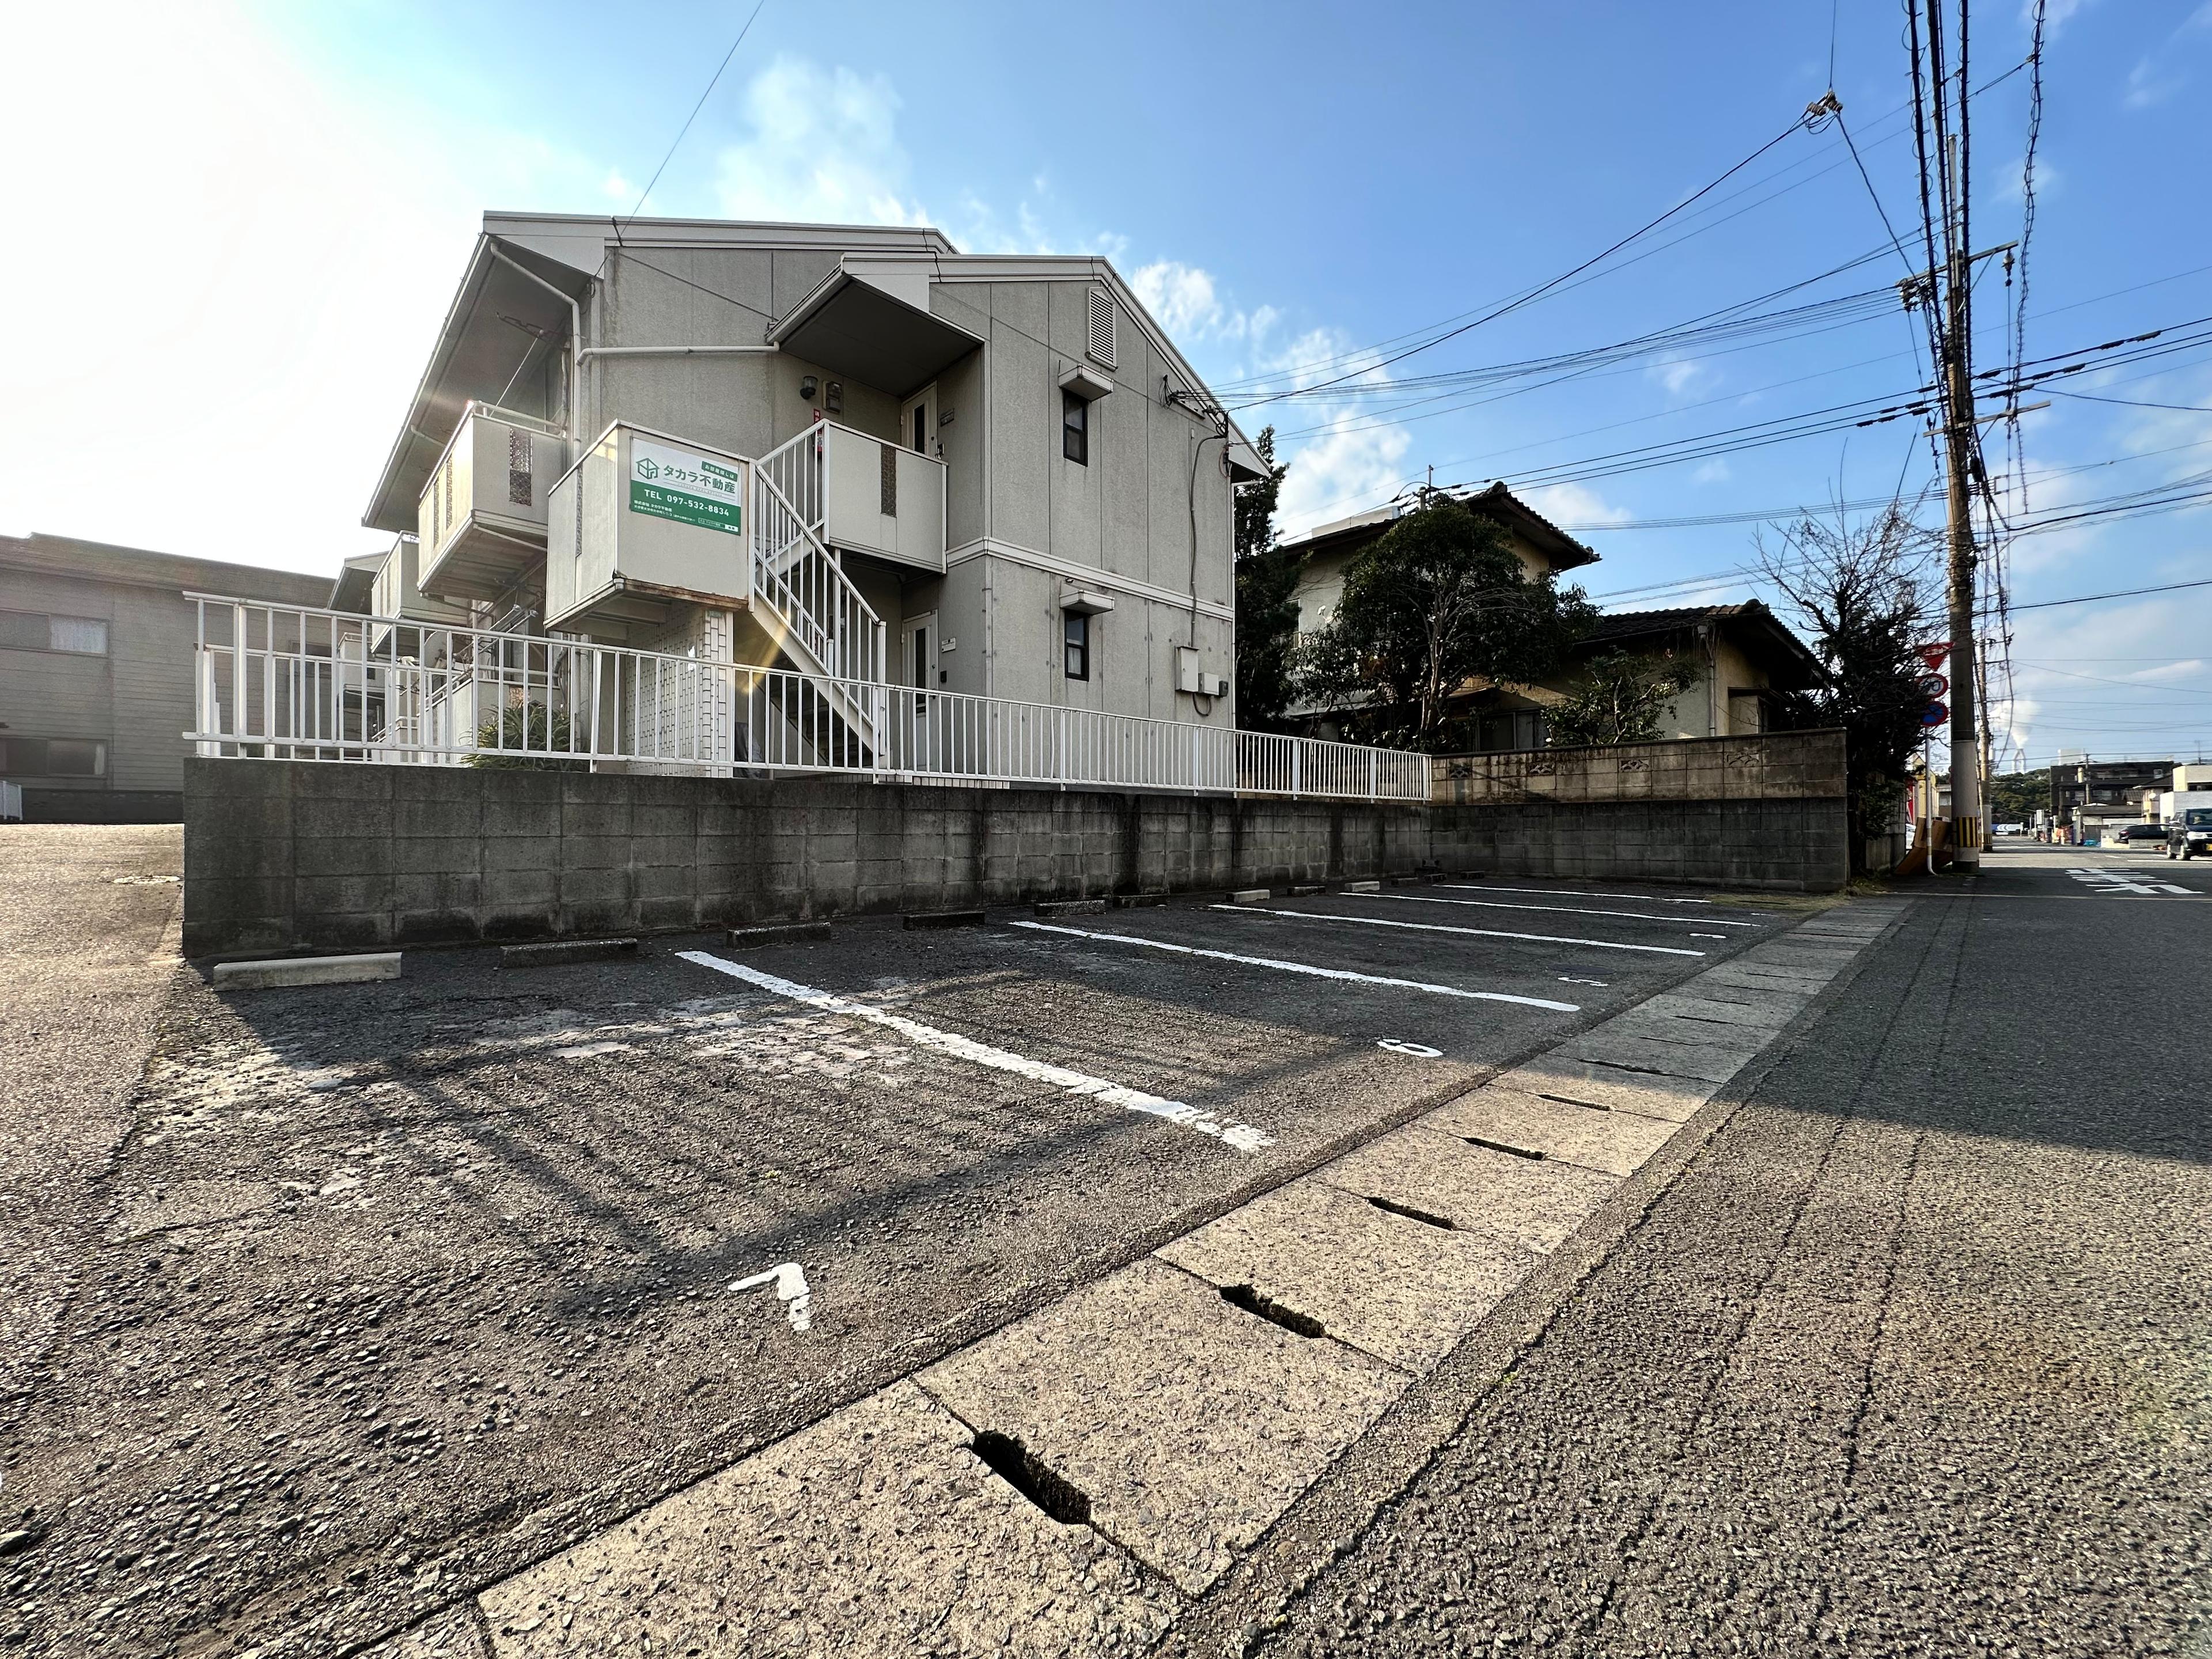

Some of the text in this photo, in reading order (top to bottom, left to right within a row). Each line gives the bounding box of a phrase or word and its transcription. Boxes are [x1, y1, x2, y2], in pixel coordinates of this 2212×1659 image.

[664, 465, 736, 494] タカラ不動産
[644, 489, 662, 500] TEL
[667, 494, 729, 517] 097-532-8834
[2065, 868, 2206, 893] 止まれ
[1377, 1039, 1443, 1057] 6
[728, 1262, 810, 1331] 7
